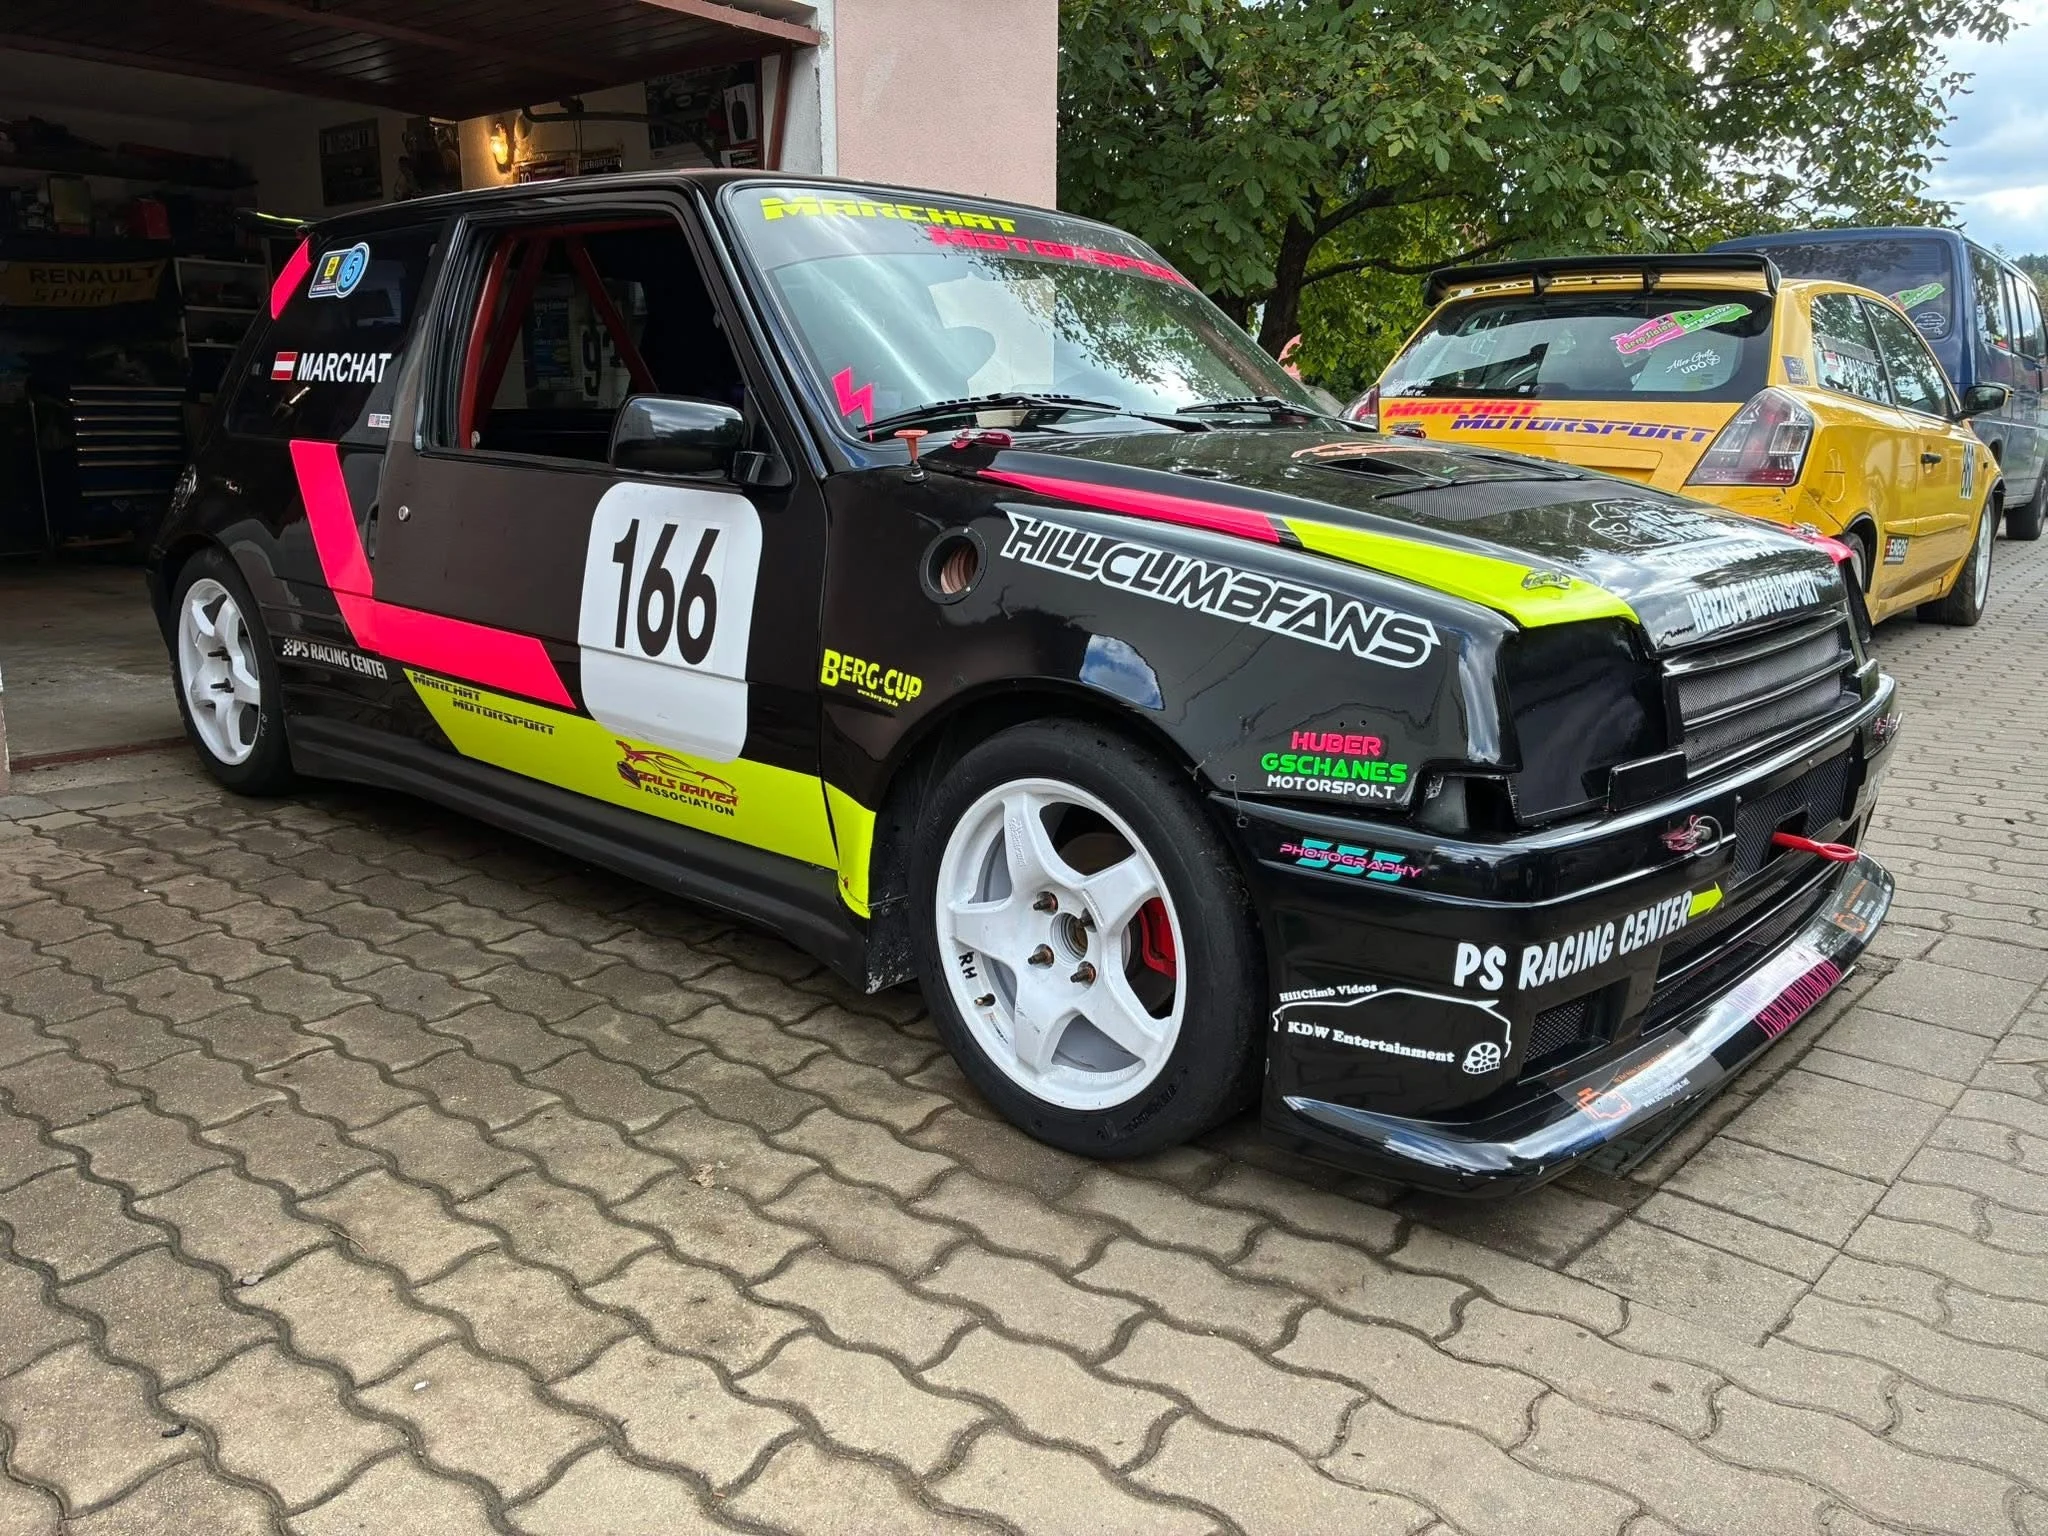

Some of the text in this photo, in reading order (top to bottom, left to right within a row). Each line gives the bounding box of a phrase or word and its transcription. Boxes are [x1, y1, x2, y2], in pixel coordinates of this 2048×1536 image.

[760, 197, 1016, 233] MARCHAT
[29, 265, 158, 284] RENAULT
[32, 287, 121, 304] SPORT
[296, 352, 393, 383] MARCHAT
[1680, 361, 1707, 375] UDO
[1383, 401, 1543, 417] MARCHAT
[1451, 414, 1715, 442] MOTORSPORT
[612, 518, 721, 665] 166
[1000, 511, 1442, 669] HILLCLIMBFANS
[293, 639, 310, 658] PS
[310, 643, 351, 668] RACING
[413, 672, 481, 701] MARCHAT
[453, 698, 555, 735] MOTORSPORT
[1291, 731, 1383, 756] HUBER
[1261, 752, 1409, 784] GSCHANES
[645, 785, 735, 817] ASSOCIATION
[680, 782, 739, 807] DRIVER
[1267, 774, 1396, 799] MOTORSPORT
[1280, 843, 1423, 877] PHOTOGRAPHY
[1454, 890, 1694, 991] PS RACING CENTER
[1279, 983, 1378, 1003] HillClimb Videos
[1288, 1021, 1455, 1063] KDW Entertainment
